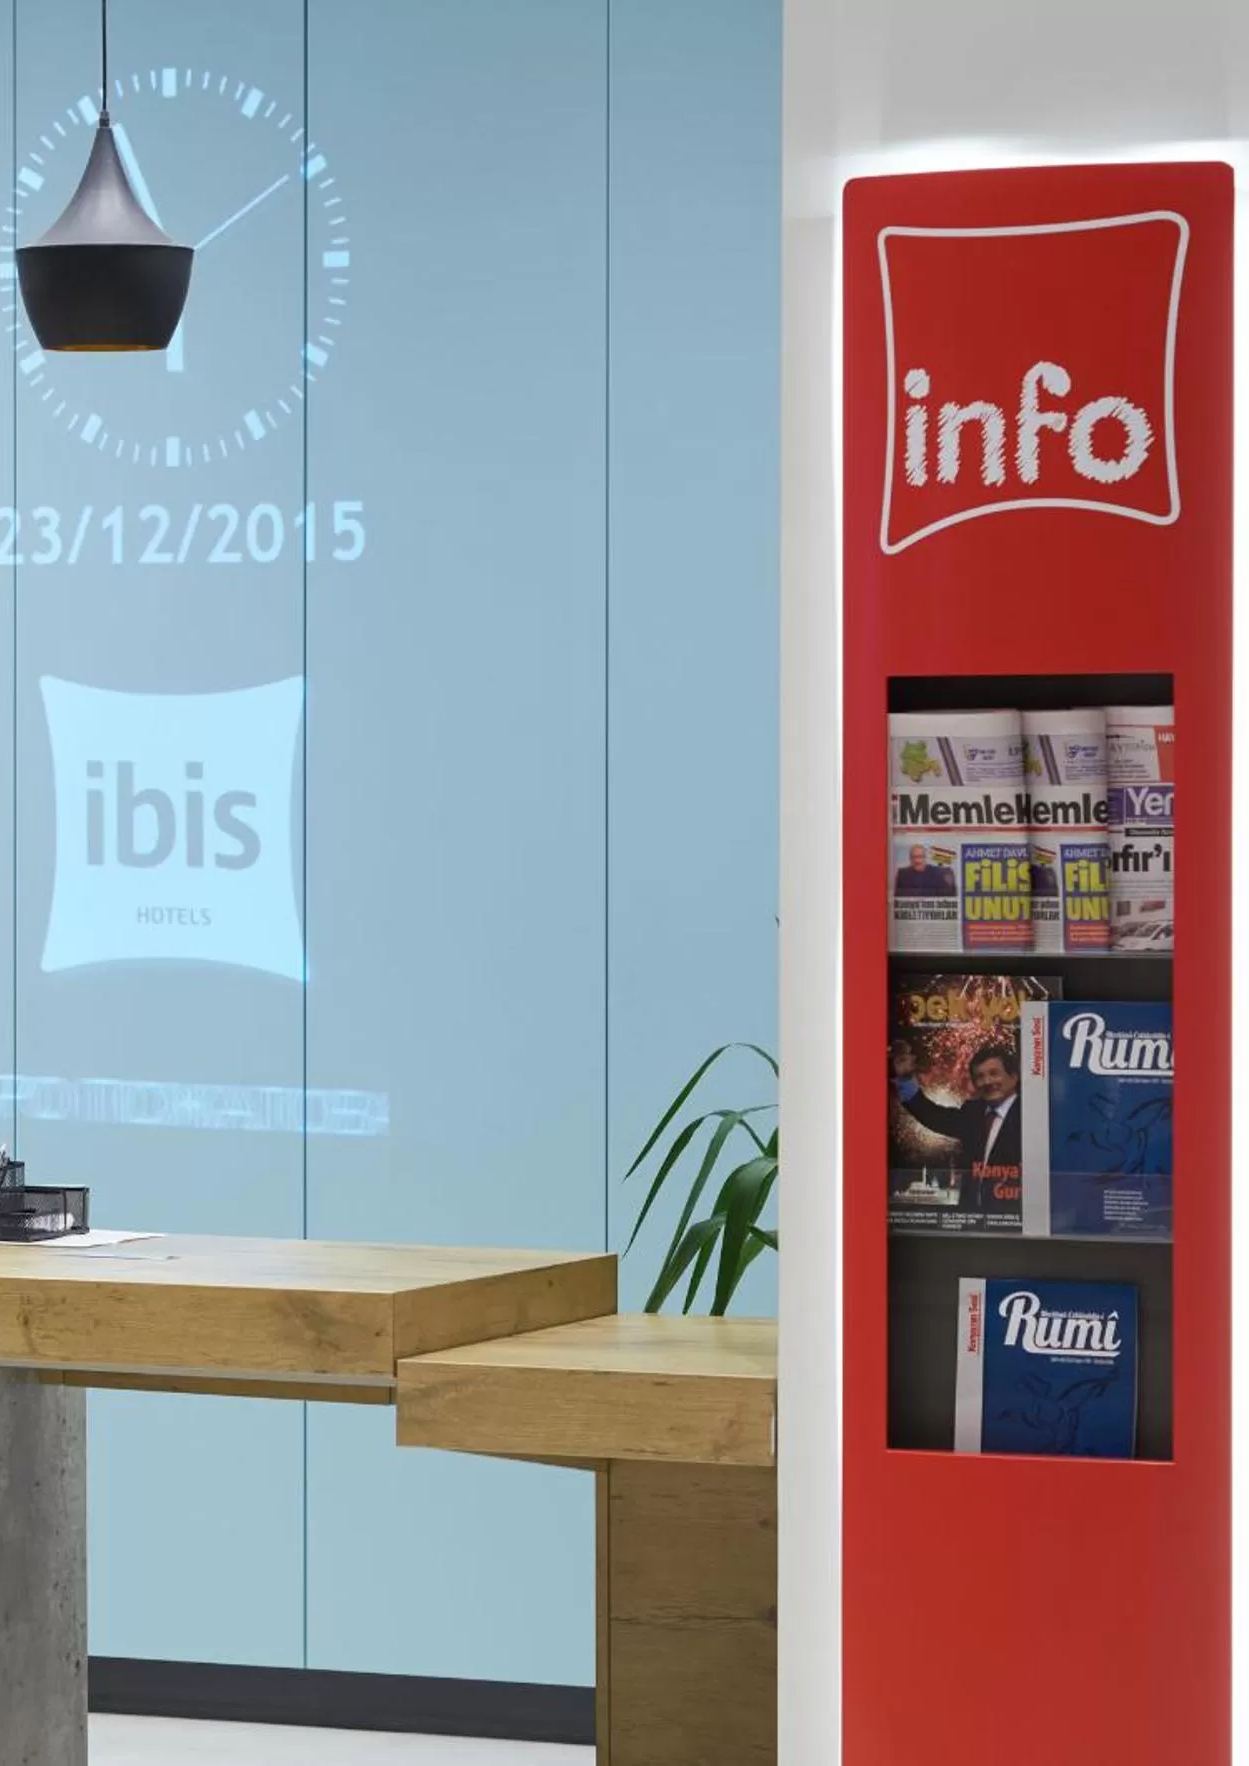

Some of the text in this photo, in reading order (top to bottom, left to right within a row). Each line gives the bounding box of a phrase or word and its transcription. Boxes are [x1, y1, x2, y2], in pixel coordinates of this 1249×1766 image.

[904, 360, 1155, 487] info
[85, 760, 261, 871] ibis
[136, 906, 212, 928] HOTELS
